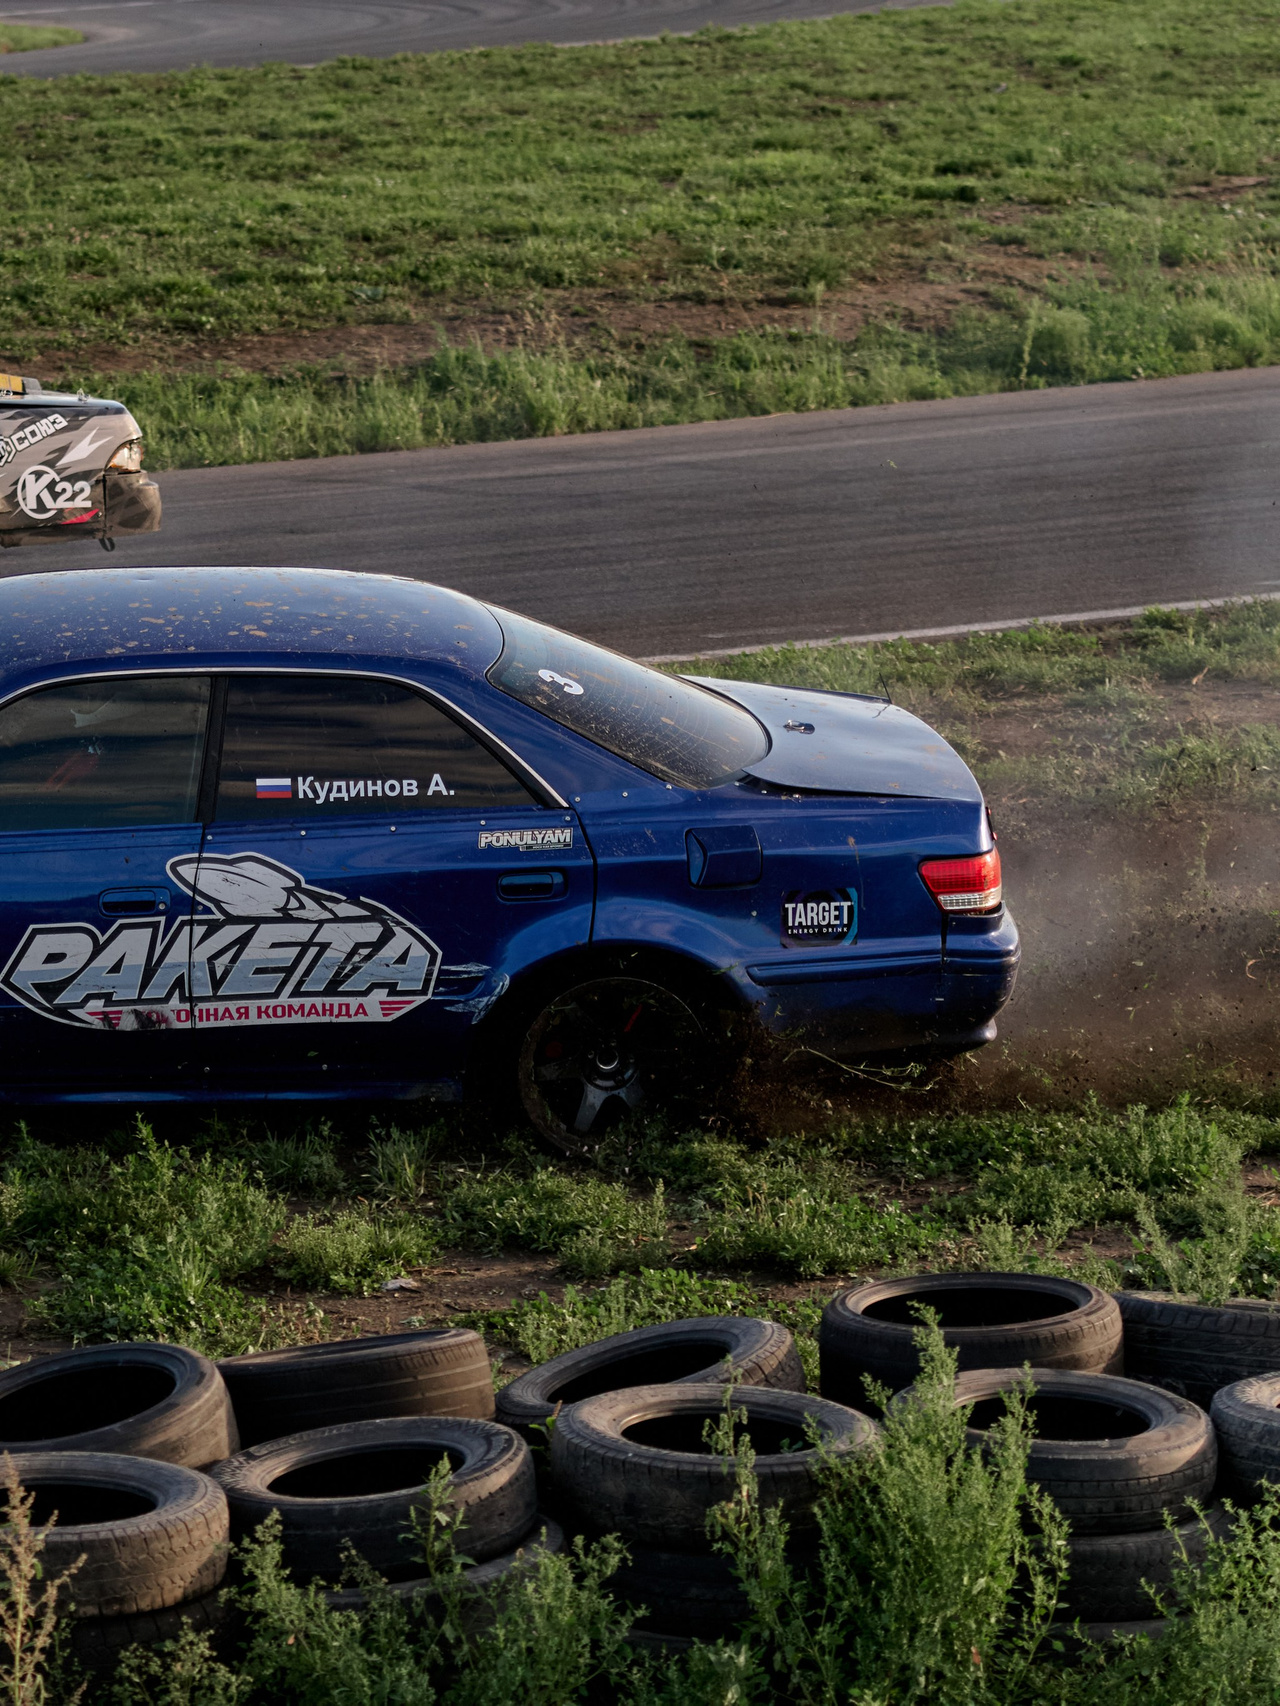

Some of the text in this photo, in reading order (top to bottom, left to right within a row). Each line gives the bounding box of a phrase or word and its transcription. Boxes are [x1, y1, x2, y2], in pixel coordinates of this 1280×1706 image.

[10, 413, 68, 452] СОЮЗ
[538, 669, 584, 695] 3
[297, 773, 455, 804] Кудинов А.
[480, 829, 571, 848] PONULYAM
[784, 901, 852, 926] TARGET
[6, 920, 432, 1004] РАКЕТА
[256, 1002, 369, 1020] КОМАНДА
